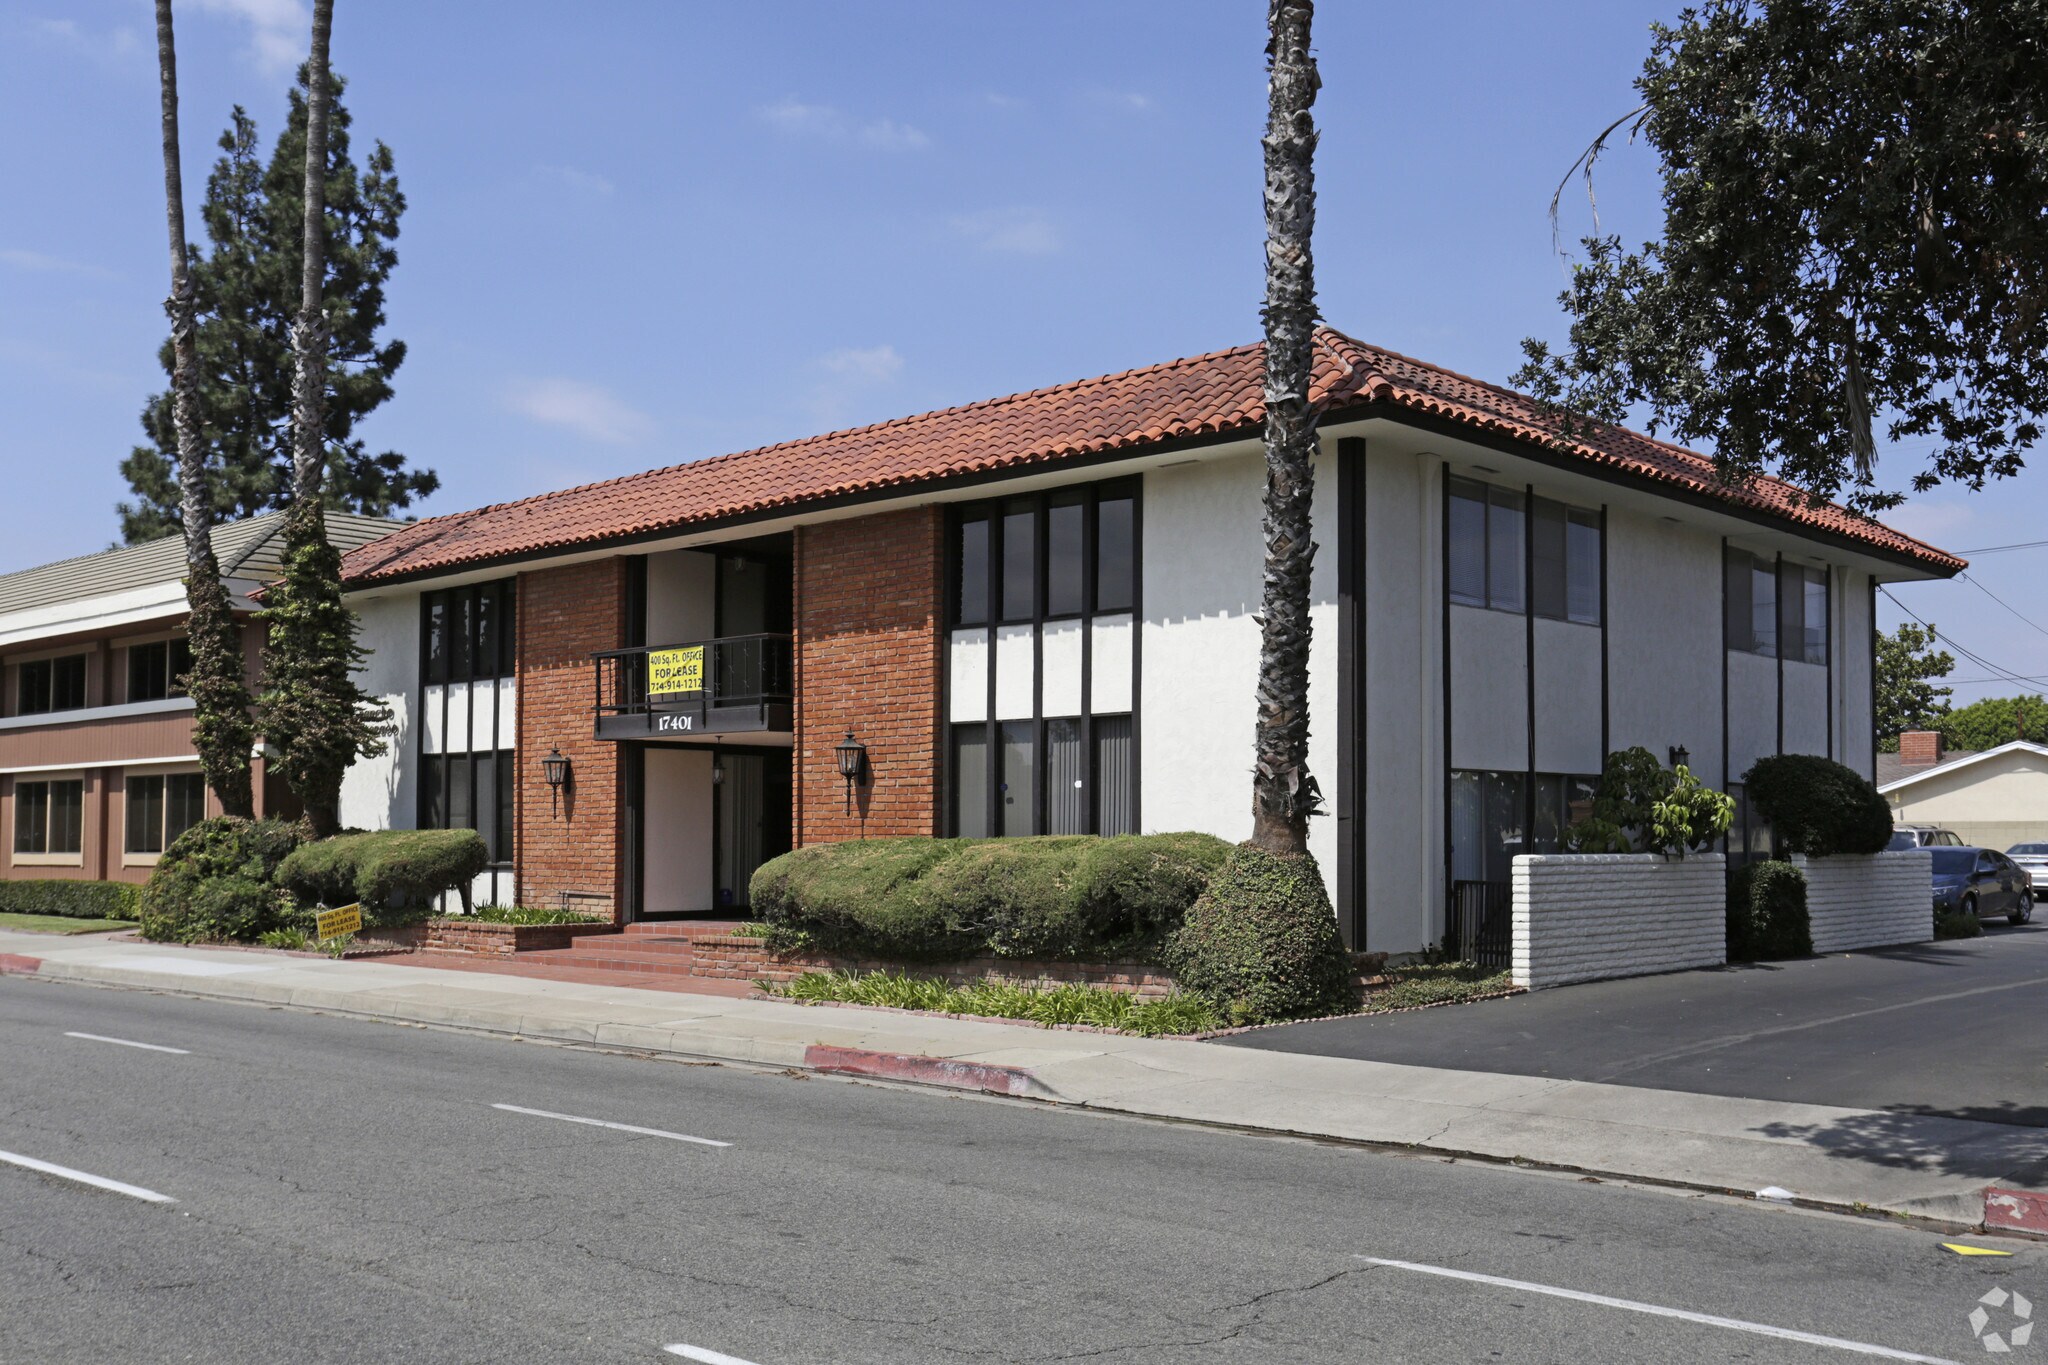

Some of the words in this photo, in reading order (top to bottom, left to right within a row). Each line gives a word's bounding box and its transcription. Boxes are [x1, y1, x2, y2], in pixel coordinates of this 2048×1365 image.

[650, 655, 662, 665] 400
[672, 653, 680, 663] Ft.
[682, 650, 703, 662] OFFICE
[655, 668, 671, 679] FOR
[672, 665, 698, 677] LEASE
[651, 678, 703, 691] 714-914-1212
[659, 715, 692, 731] 17401
[322, 920, 336, 929] FOR
[336, 915, 356, 925] LEASE
[320, 922, 360, 938] 714-914-1212
